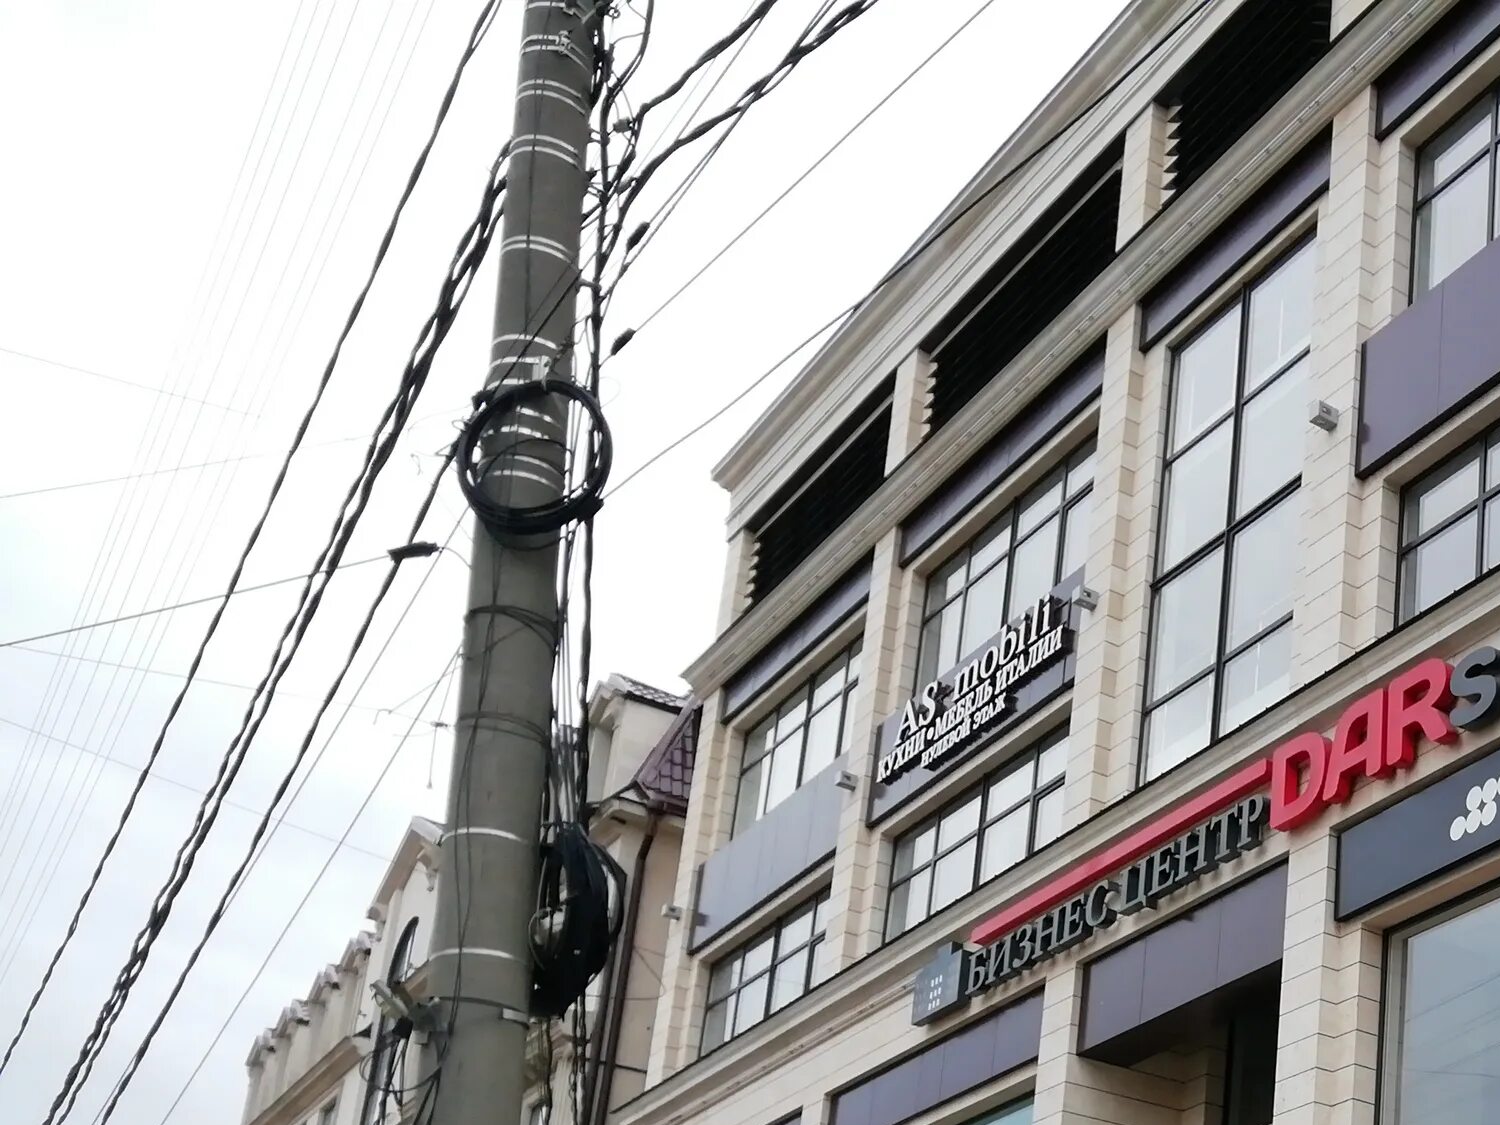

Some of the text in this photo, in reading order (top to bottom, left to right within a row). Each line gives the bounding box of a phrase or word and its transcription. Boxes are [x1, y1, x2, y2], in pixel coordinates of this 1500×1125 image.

[876, 624, 1065, 783] КУХНИ МЕБЕЛЬ ИТАЛИИ
[894, 593, 1051, 745] AS mobili
[920, 693, 1007, 769] НУЛЕВОЙ ЭТАЖ
[965, 794, 1265, 997] БИЗНЕС ЦЕНТР
